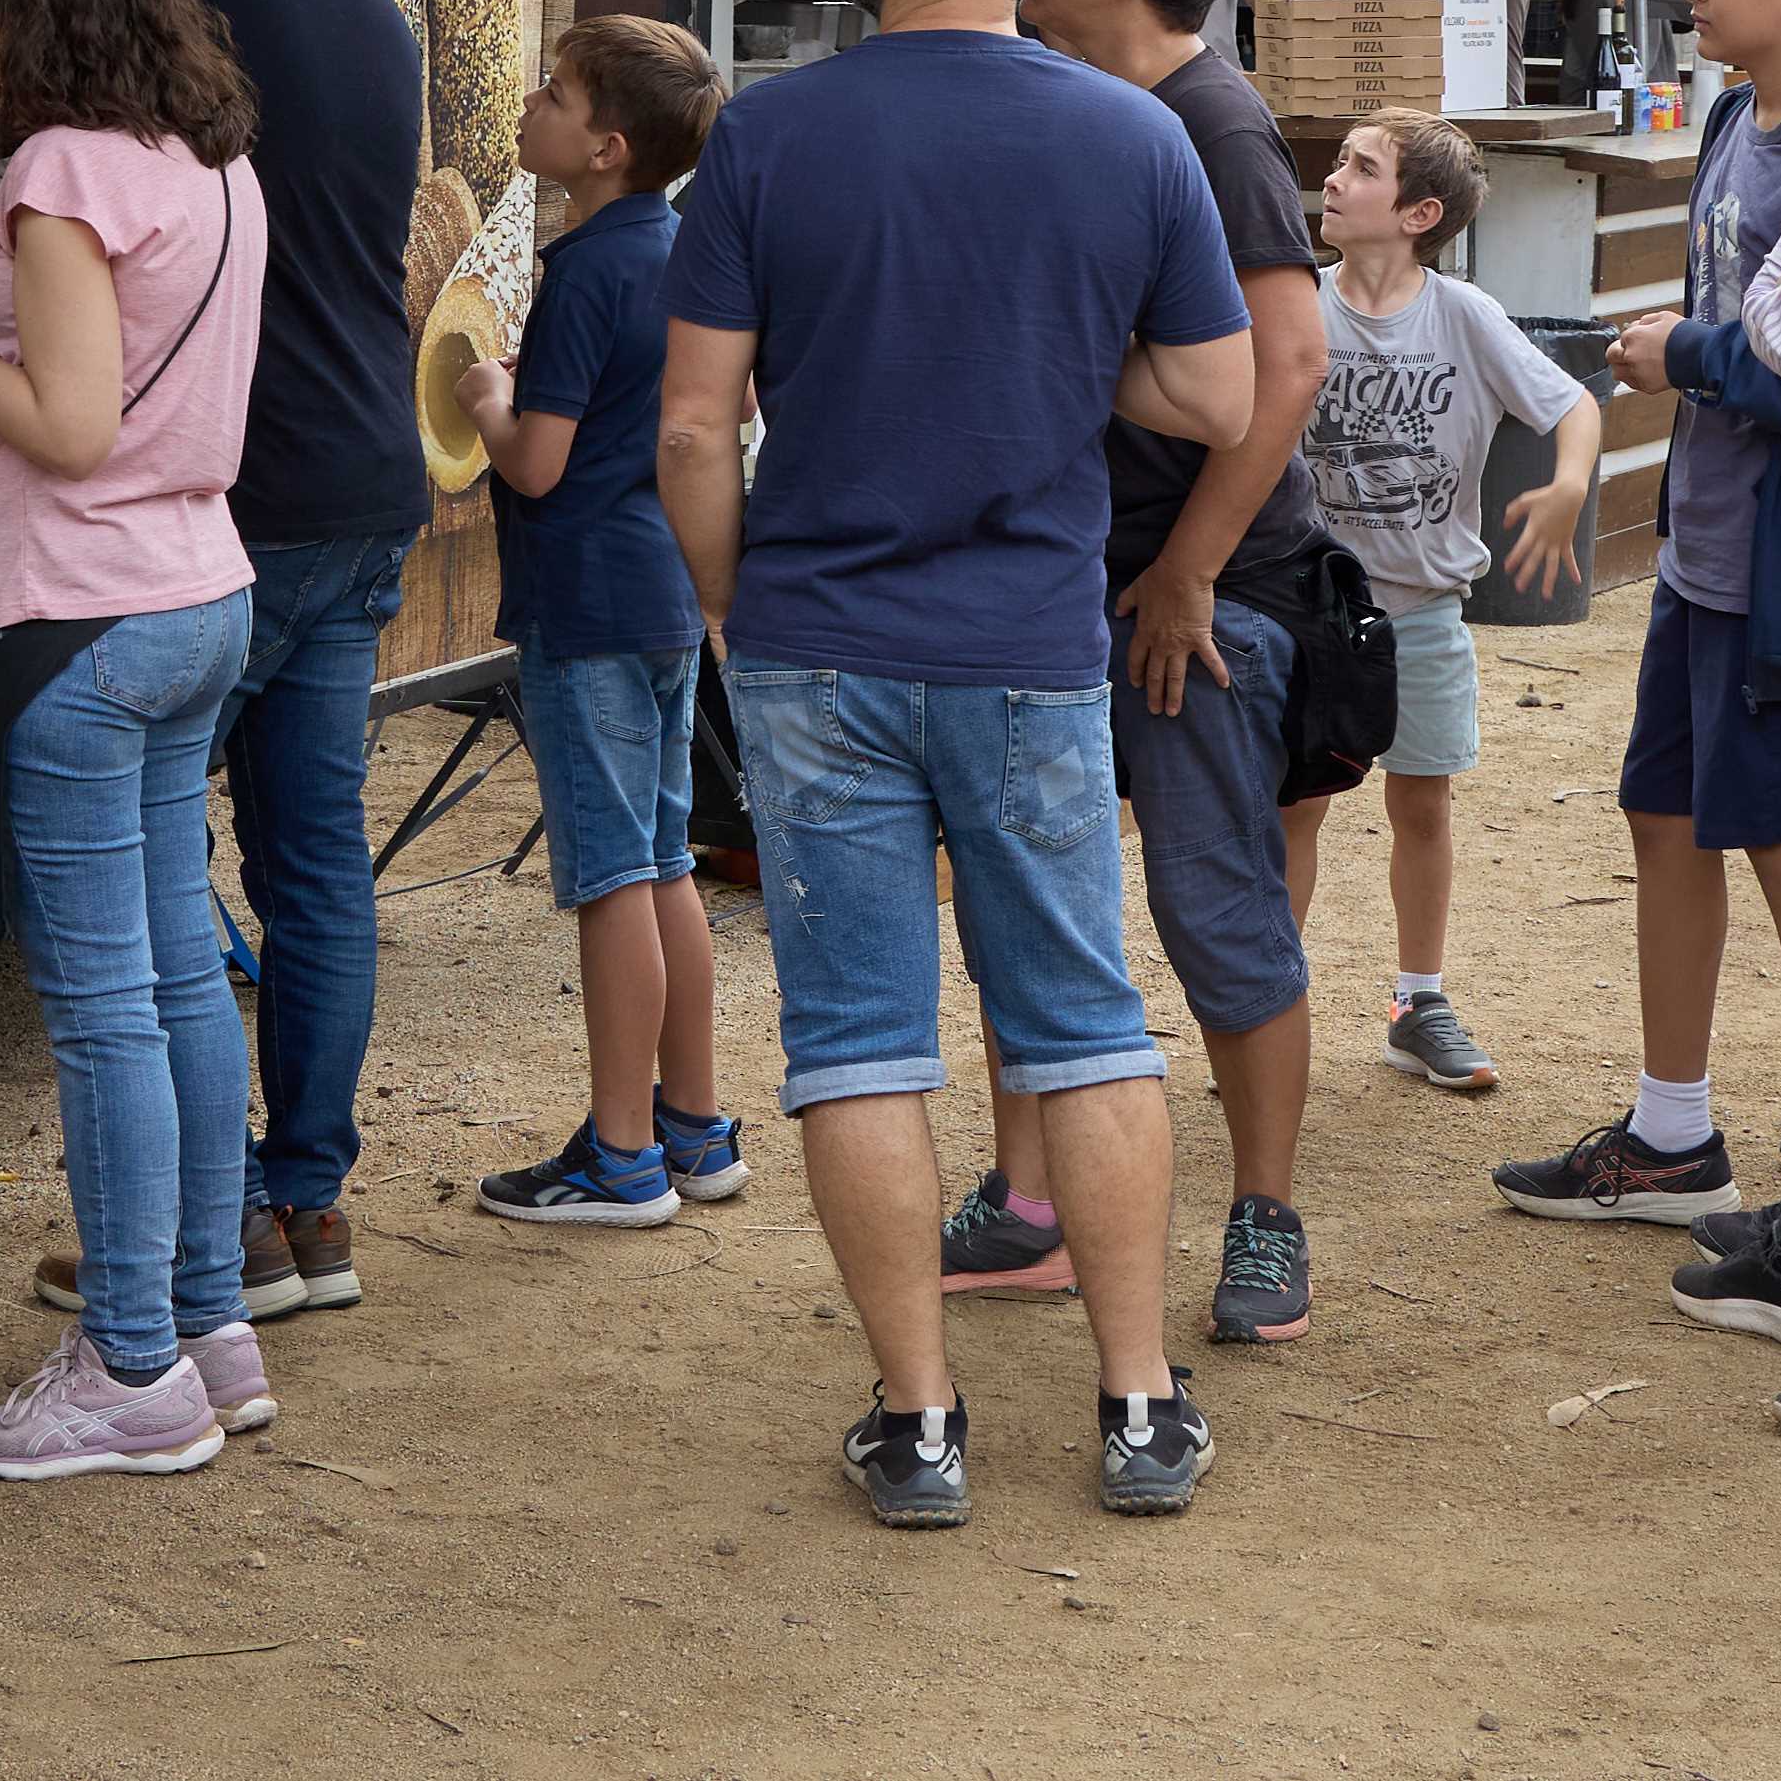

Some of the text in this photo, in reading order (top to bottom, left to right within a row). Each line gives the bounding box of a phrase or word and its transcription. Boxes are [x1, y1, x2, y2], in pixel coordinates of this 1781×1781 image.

[1354, 1, 1384, 13] PIZZA
[1351, 21, 1383, 33] PIZZA
[1353, 41, 1384, 53] PIZZA
[1354, 61, 1384, 73] PIZZA
[1355, 80, 1387, 92] PIZZA
[1352, 99, 1383, 110] PIZZA
[1358, 352, 1397, 365] TIME FOR
[1314, 363, 1457, 416] ACING
[1361, 517, 1405, 532] ACCELERATE
